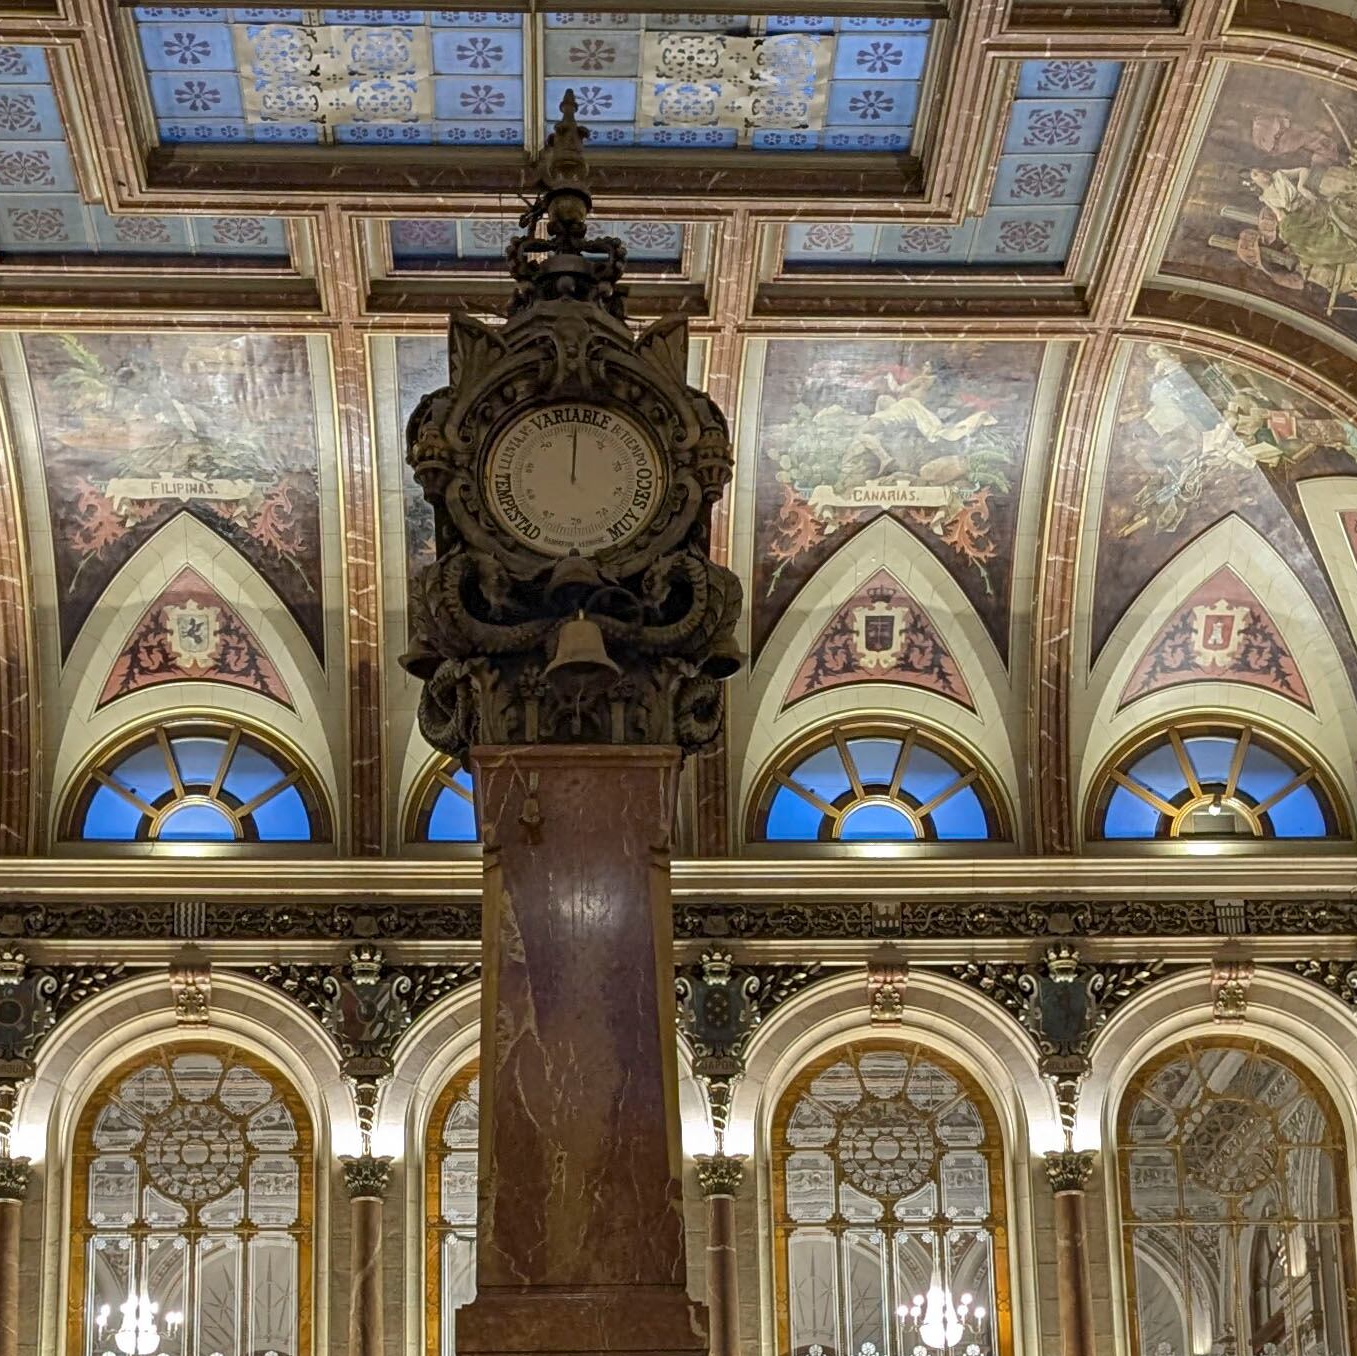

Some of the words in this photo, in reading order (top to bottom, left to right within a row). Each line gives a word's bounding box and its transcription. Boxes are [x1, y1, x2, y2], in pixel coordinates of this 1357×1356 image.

[529, 408, 612, 431] VARIABLE
[495, 473, 541, 540] TEMPESTAD
[633, 468, 652, 510] SECO
[606, 508, 640, 542] MUY
